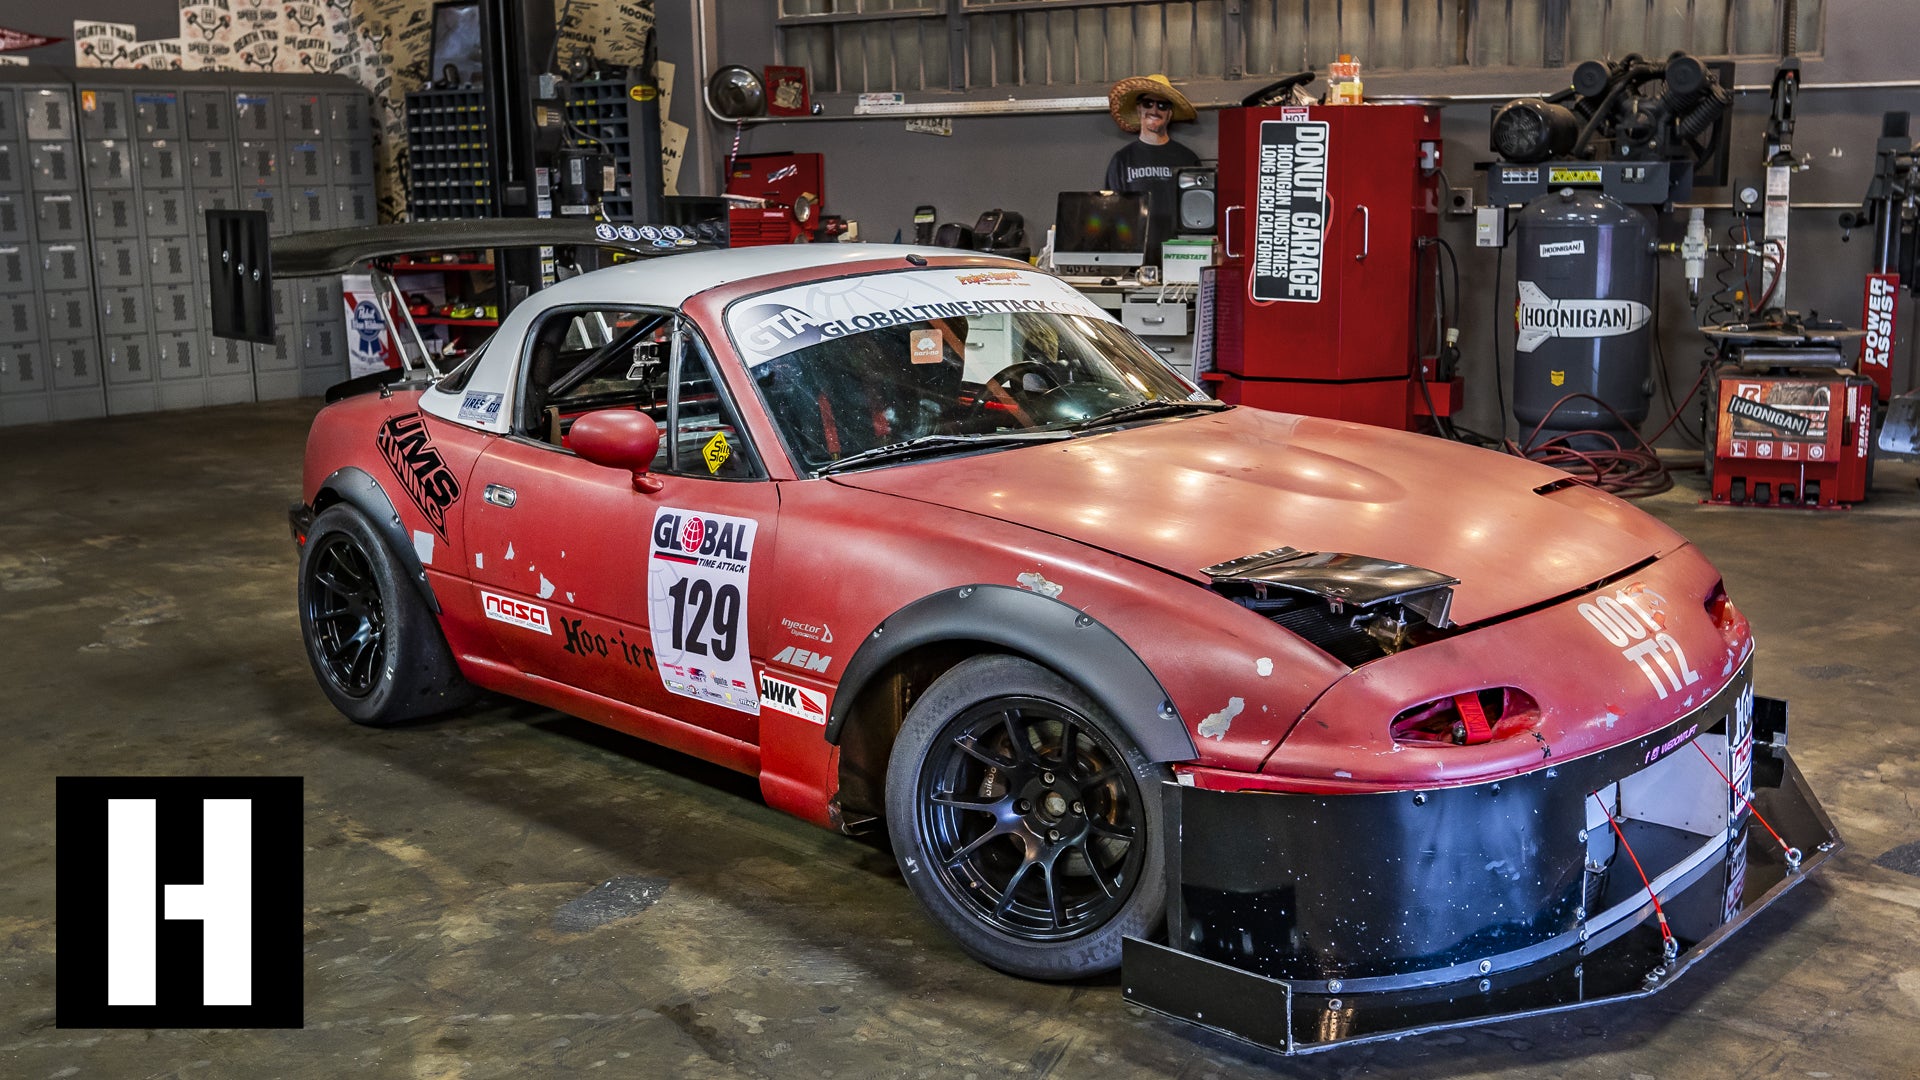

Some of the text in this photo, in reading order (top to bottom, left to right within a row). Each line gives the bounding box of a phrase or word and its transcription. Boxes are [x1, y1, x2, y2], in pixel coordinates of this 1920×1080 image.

[76, 26, 107, 40] DEATH
[1257, 144, 1277, 277] LONG BEACH CALIFORNIA
[1272, 144, 1294, 278] HOONIGAN INDUSTRIES
[1288, 126, 1326, 298] DONUT GARAGE
[1164, 253, 1208, 261] INTERSTATE
[741, 307, 820, 351] GTA
[1865, 277, 1883, 365] POWER
[1876, 280, 1896, 369] ASSIST
[463, 397, 484, 410] TIRES
[1857, 404, 1867, 458] TOWER
[378, 420, 443, 527] TUNING
[386, 411, 460, 507] UMS
[654, 513, 749, 562] GLOBAL
[699, 558, 746, 574] TIME ATTACK
[559, 616, 655, 671] Hooier
[669, 576, 741, 662] 129
[781, 617, 822, 633] Injector
[771, 646, 833, 674] AEM
[1622, 632, 1700, 700] TT2
